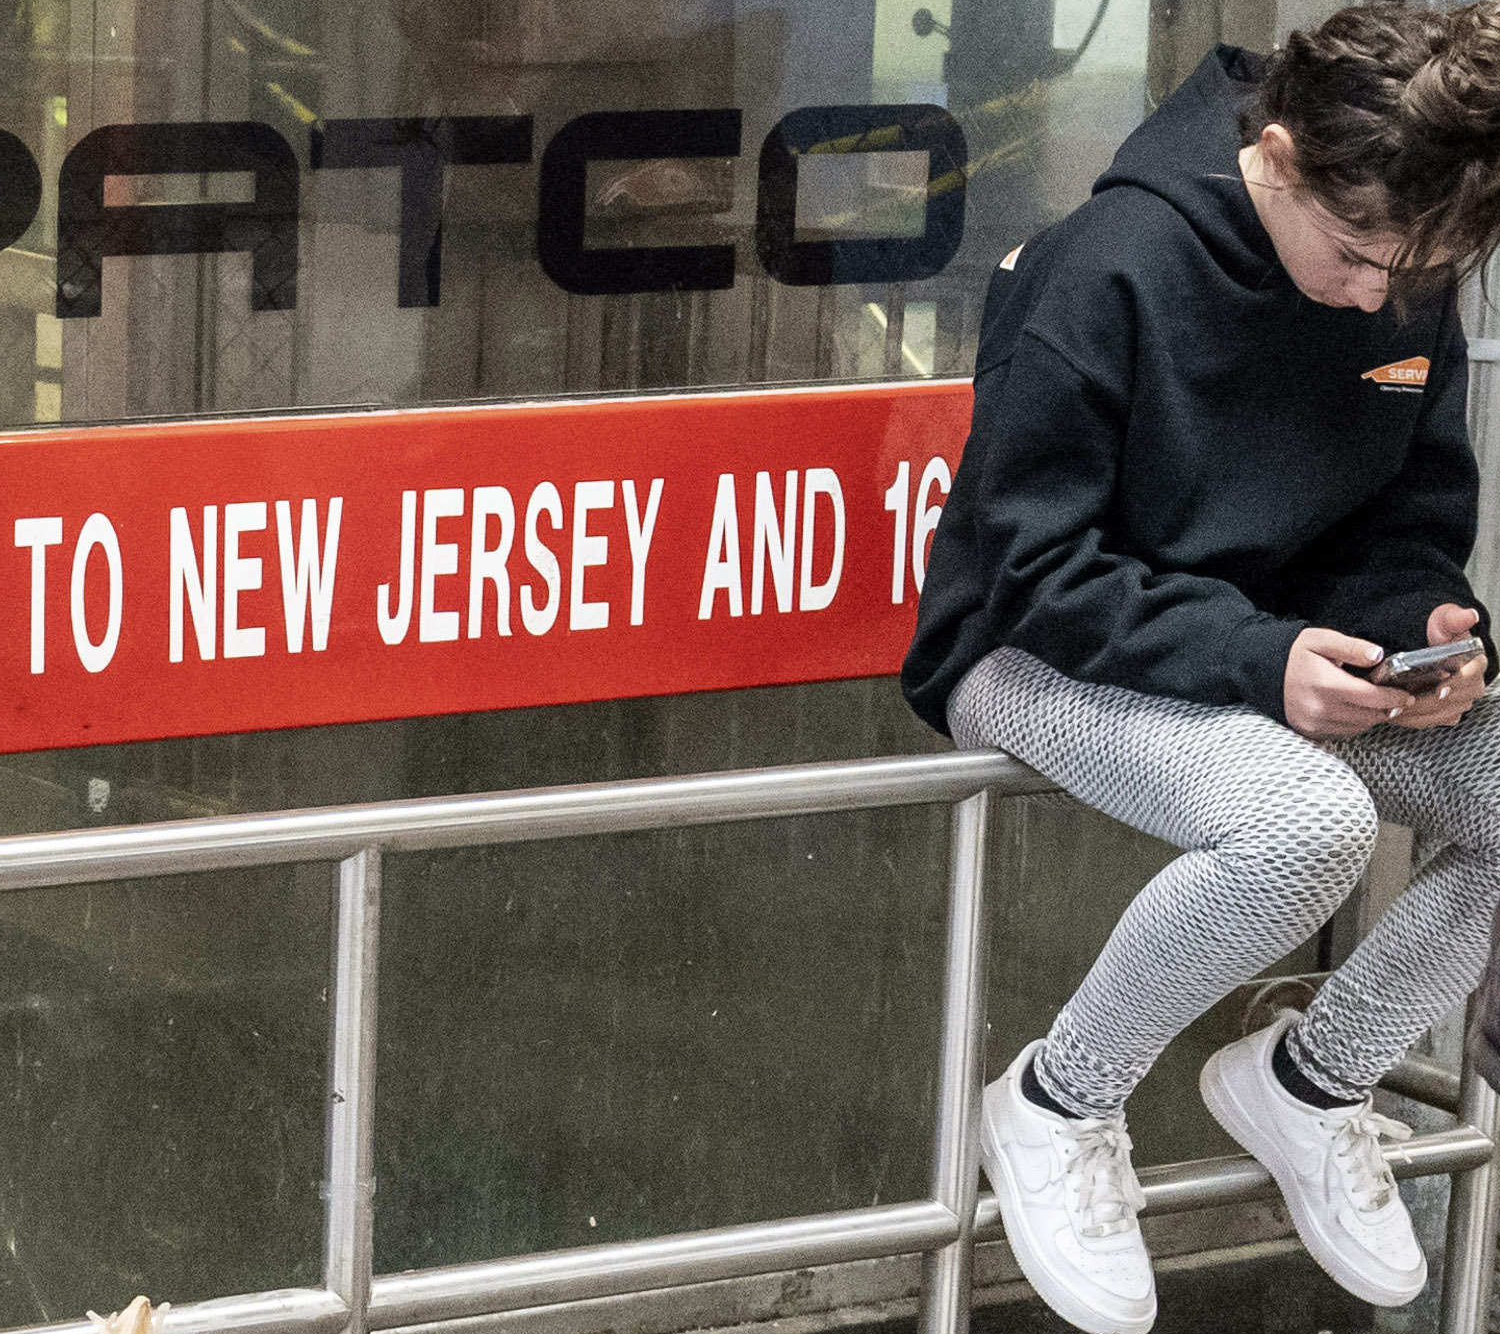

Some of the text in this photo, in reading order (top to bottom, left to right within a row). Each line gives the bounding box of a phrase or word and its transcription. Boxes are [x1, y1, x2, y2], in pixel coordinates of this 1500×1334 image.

[14, 512, 124, 675] TO
[168, 497, 343, 663] NEW
[376, 478, 665, 645] JERSEY
[698, 468, 847, 622] AND
[884, 456, 953, 605] 16
